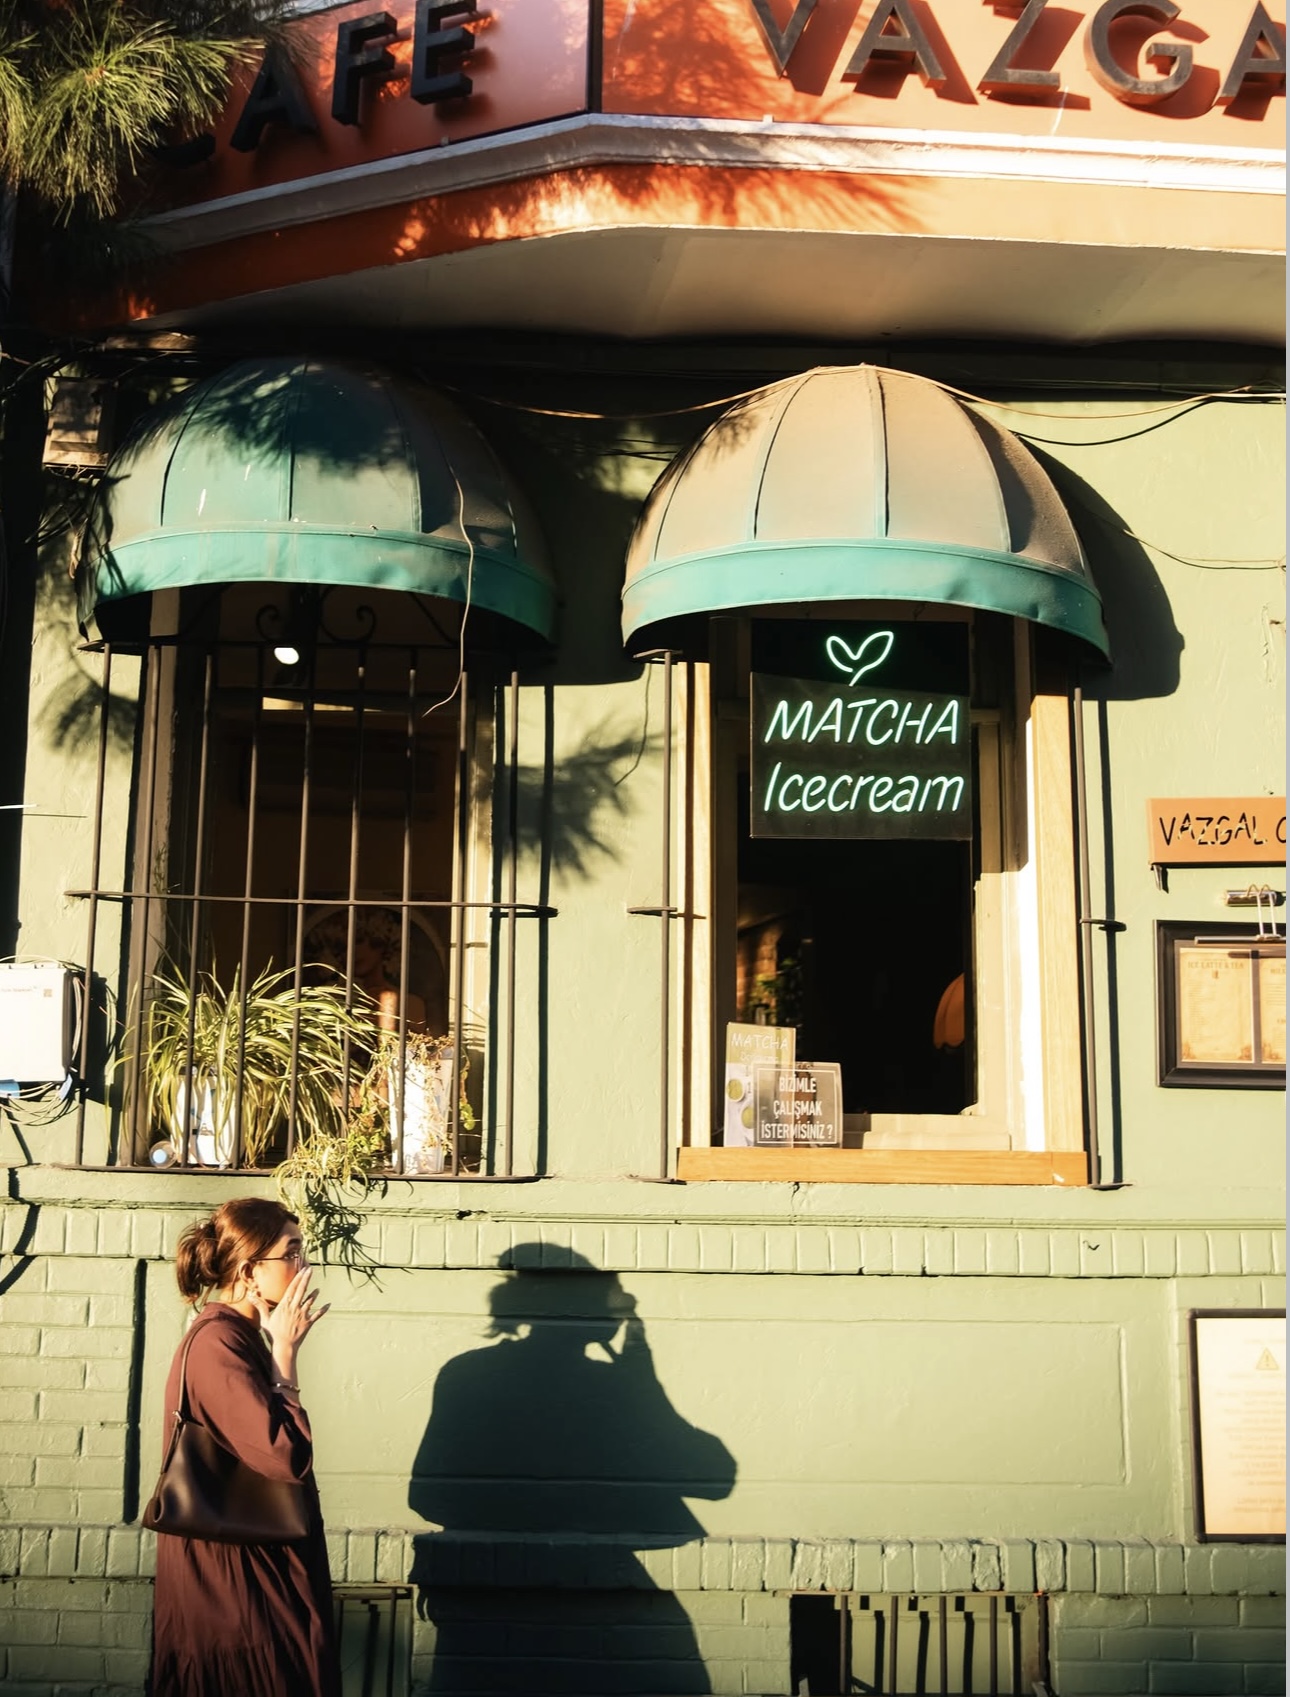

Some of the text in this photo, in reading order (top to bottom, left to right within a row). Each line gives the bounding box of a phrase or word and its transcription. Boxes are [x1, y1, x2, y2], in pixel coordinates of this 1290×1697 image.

[148, 0, 476, 167] AFE
[764, 697, 960, 746] MATCHA
[763, 761, 965, 812] Icecream
[1159, 812, 1268, 846] VAZGAL
[731, 1032, 789, 1050] MATCHA
[773, 1100, 823, 1119] ÇALIŞMAK
